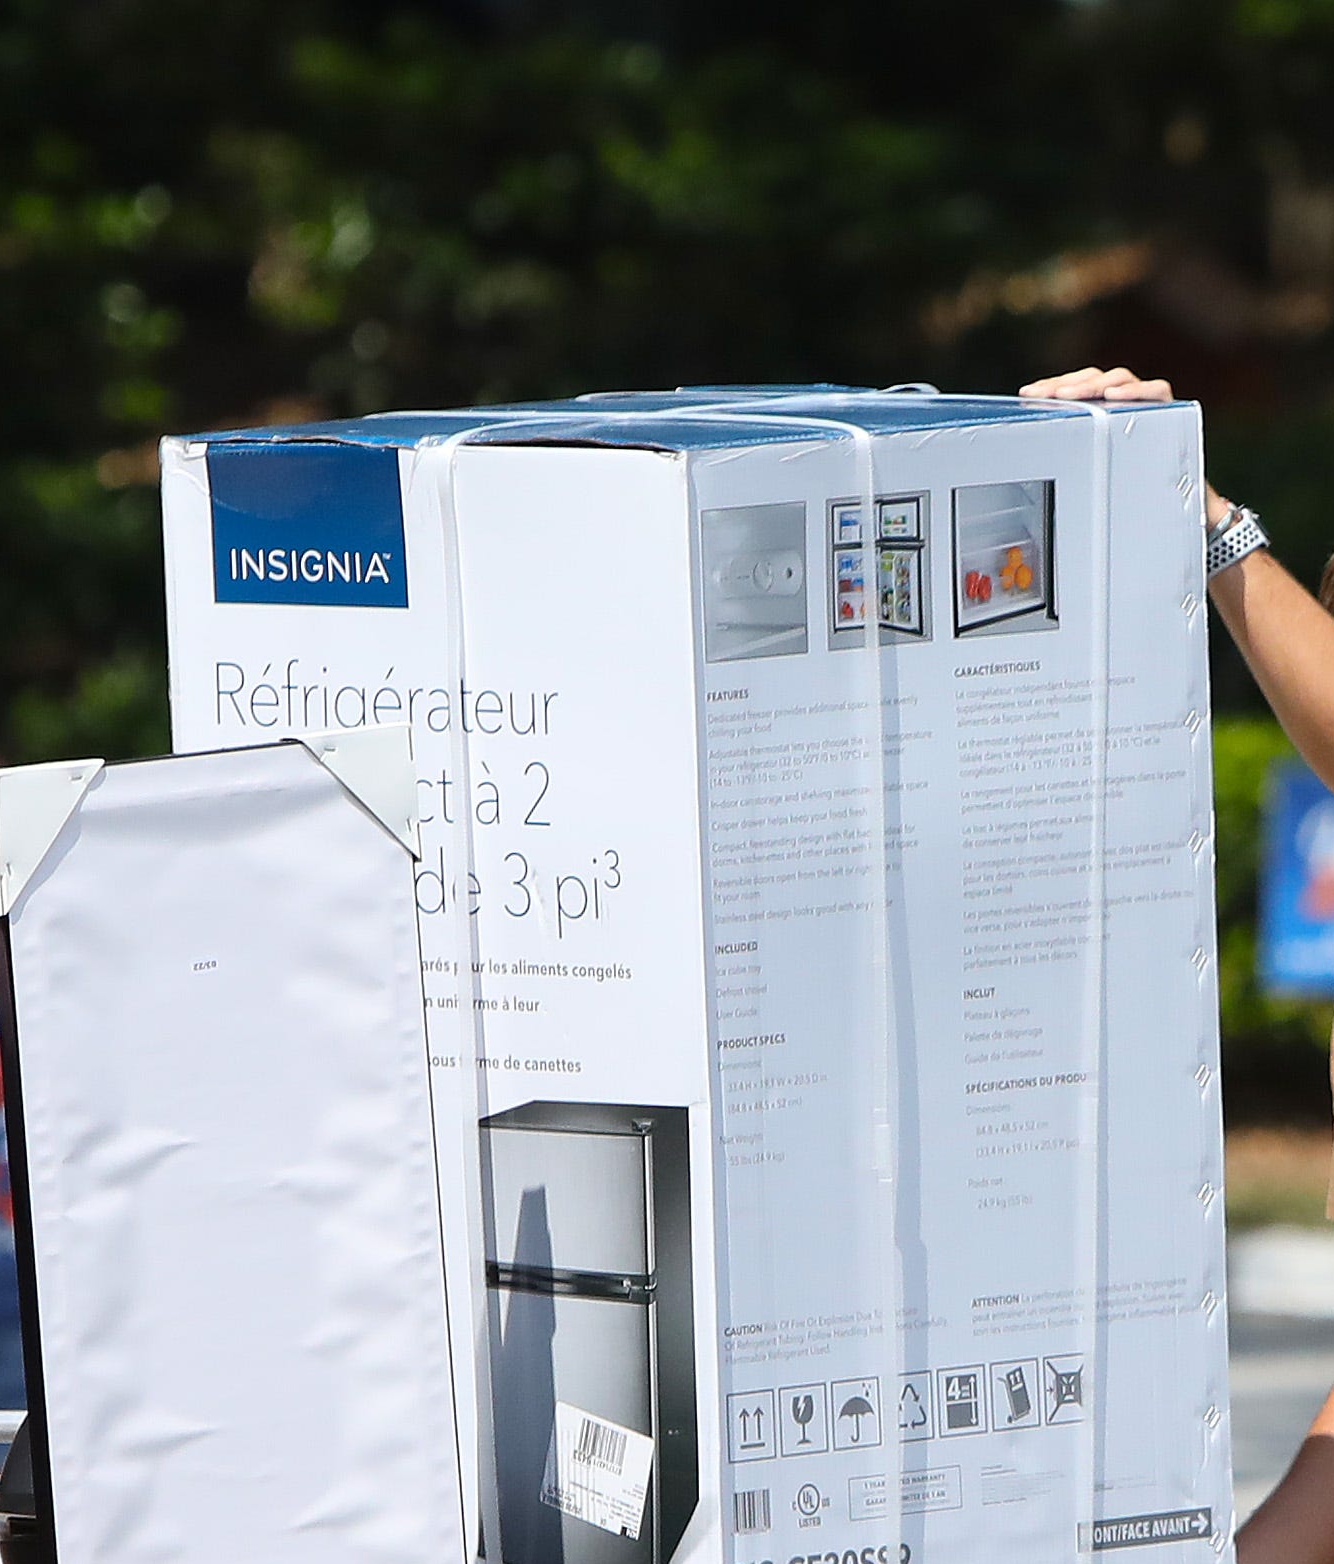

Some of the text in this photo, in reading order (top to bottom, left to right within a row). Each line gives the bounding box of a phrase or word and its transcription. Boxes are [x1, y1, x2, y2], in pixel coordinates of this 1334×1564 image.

[953, 658, 1041, 677] CARACTÉRISTIQUES
[707, 688, 749, 701] FEATURES
[474, 761, 501, 826] à
[523, 761, 552, 827] 2
[504, 852, 532, 918] 3
[714, 941, 758, 954] INCLUDED
[511, 959, 569, 978] aliments
[572, 962, 632, 983] congelés
[963, 987, 995, 999] INCLUT
[513, 996, 541, 1013] leur
[716, 1033, 785, 1050] PRODUCT SPECS
[523, 1057, 582, 1074] canettes
[965, 1071, 1086, 1093] SPÉCIFICATIONS DU PRODU
[971, 1294, 1019, 1308] ATTENTION
[724, 1323, 762, 1336] CAUTION
[1093, 1515, 1190, 1545] ONT/FACE AVANT
